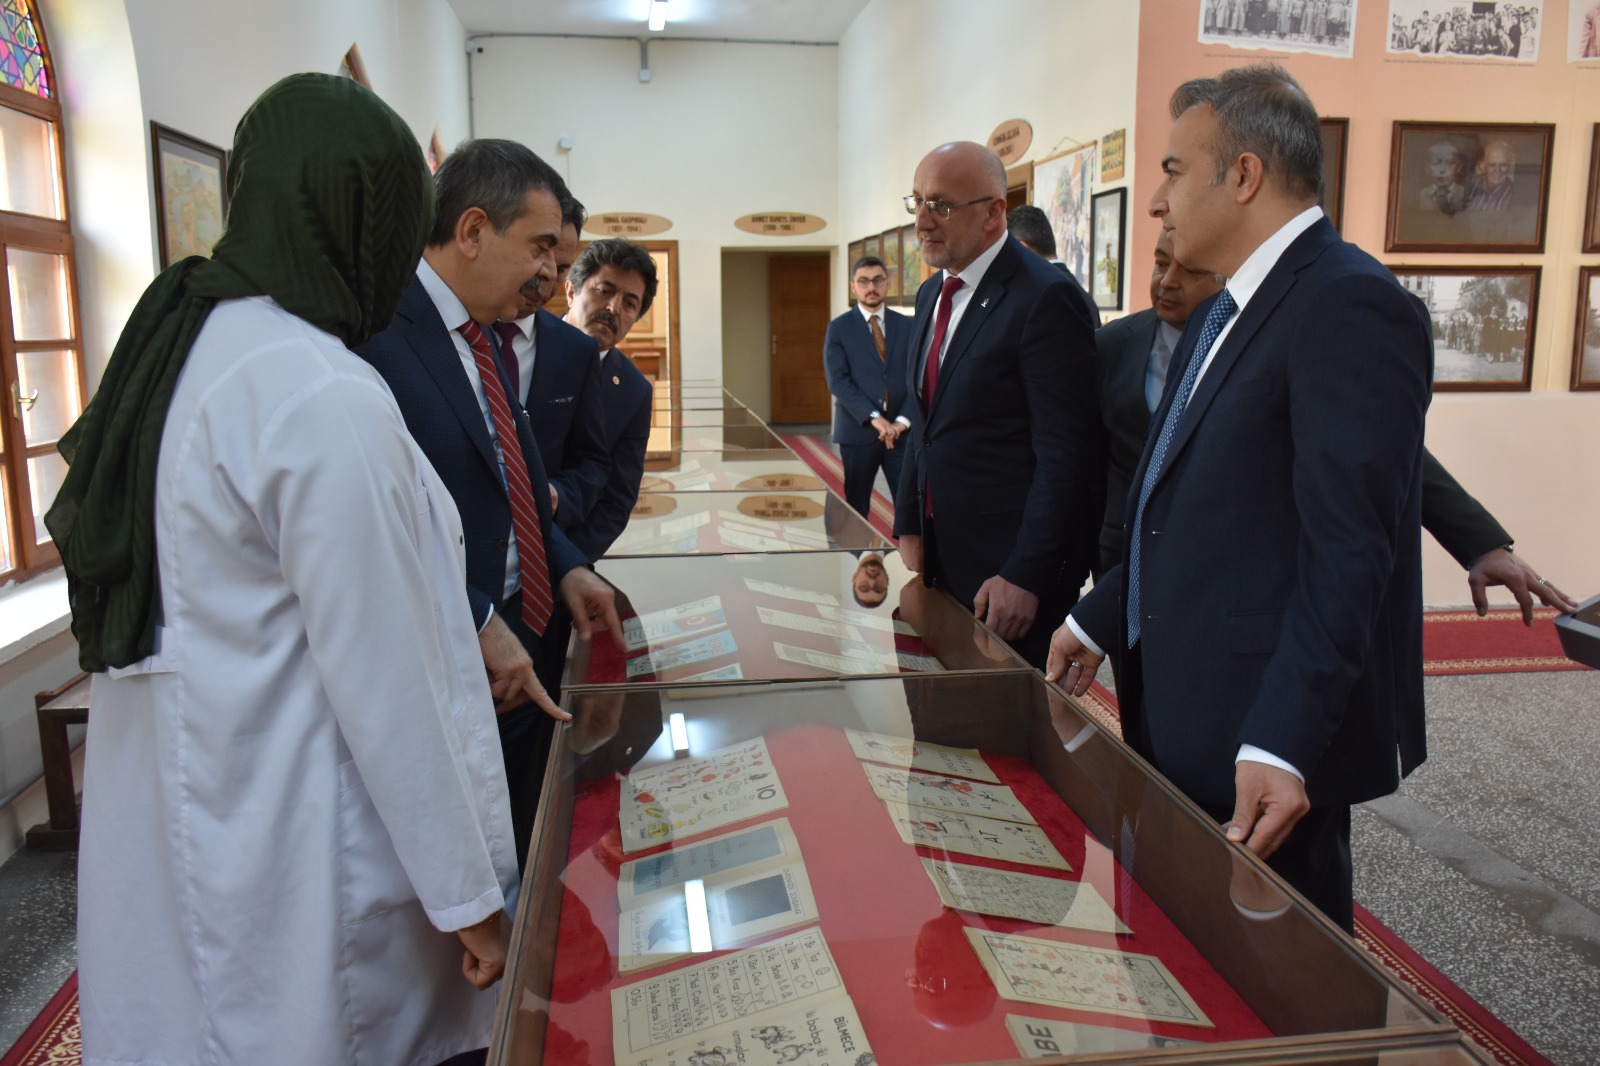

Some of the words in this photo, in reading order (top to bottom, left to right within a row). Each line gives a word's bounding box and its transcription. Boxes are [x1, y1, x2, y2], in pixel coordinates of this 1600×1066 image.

[756, 784, 776, 800] 10
[979, 830, 1002, 844] AT
[807, 1018, 823, 1045] baba
[834, 1016, 856, 1053] BİLMECE
